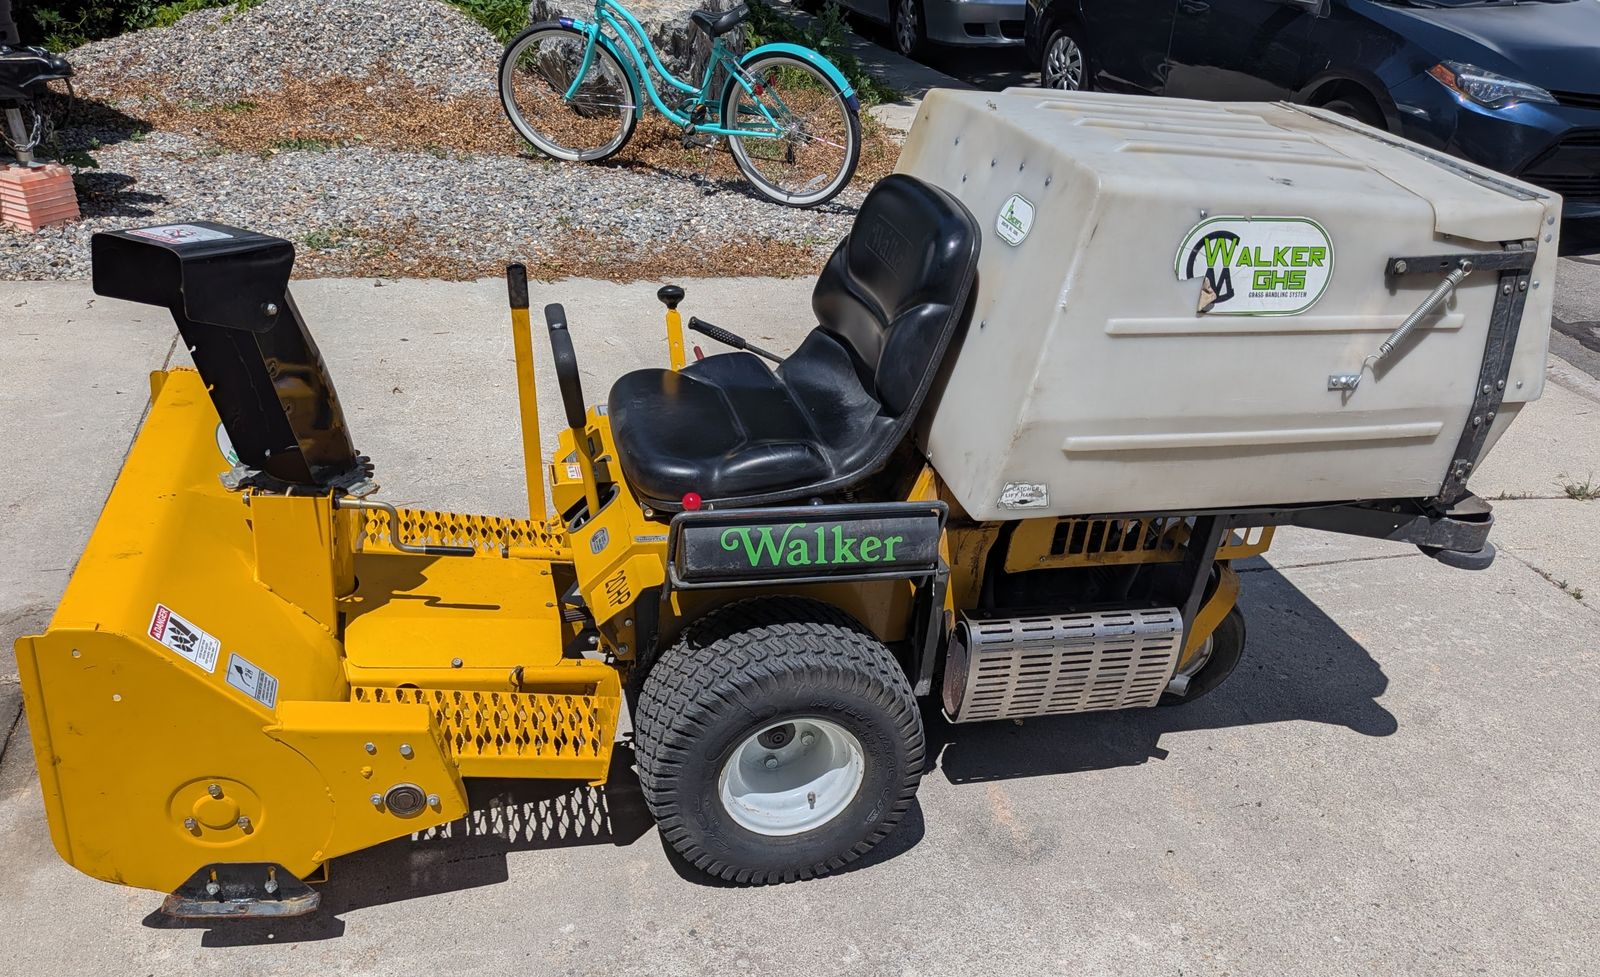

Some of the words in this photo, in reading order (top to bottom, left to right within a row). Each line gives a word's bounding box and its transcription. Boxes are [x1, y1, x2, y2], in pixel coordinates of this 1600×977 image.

[1204, 237, 1326, 267] WALKER
[1252, 270, 1306, 290] GHS
[720, 522, 903, 567] Walker
[154, 607, 169, 633] DANGER
